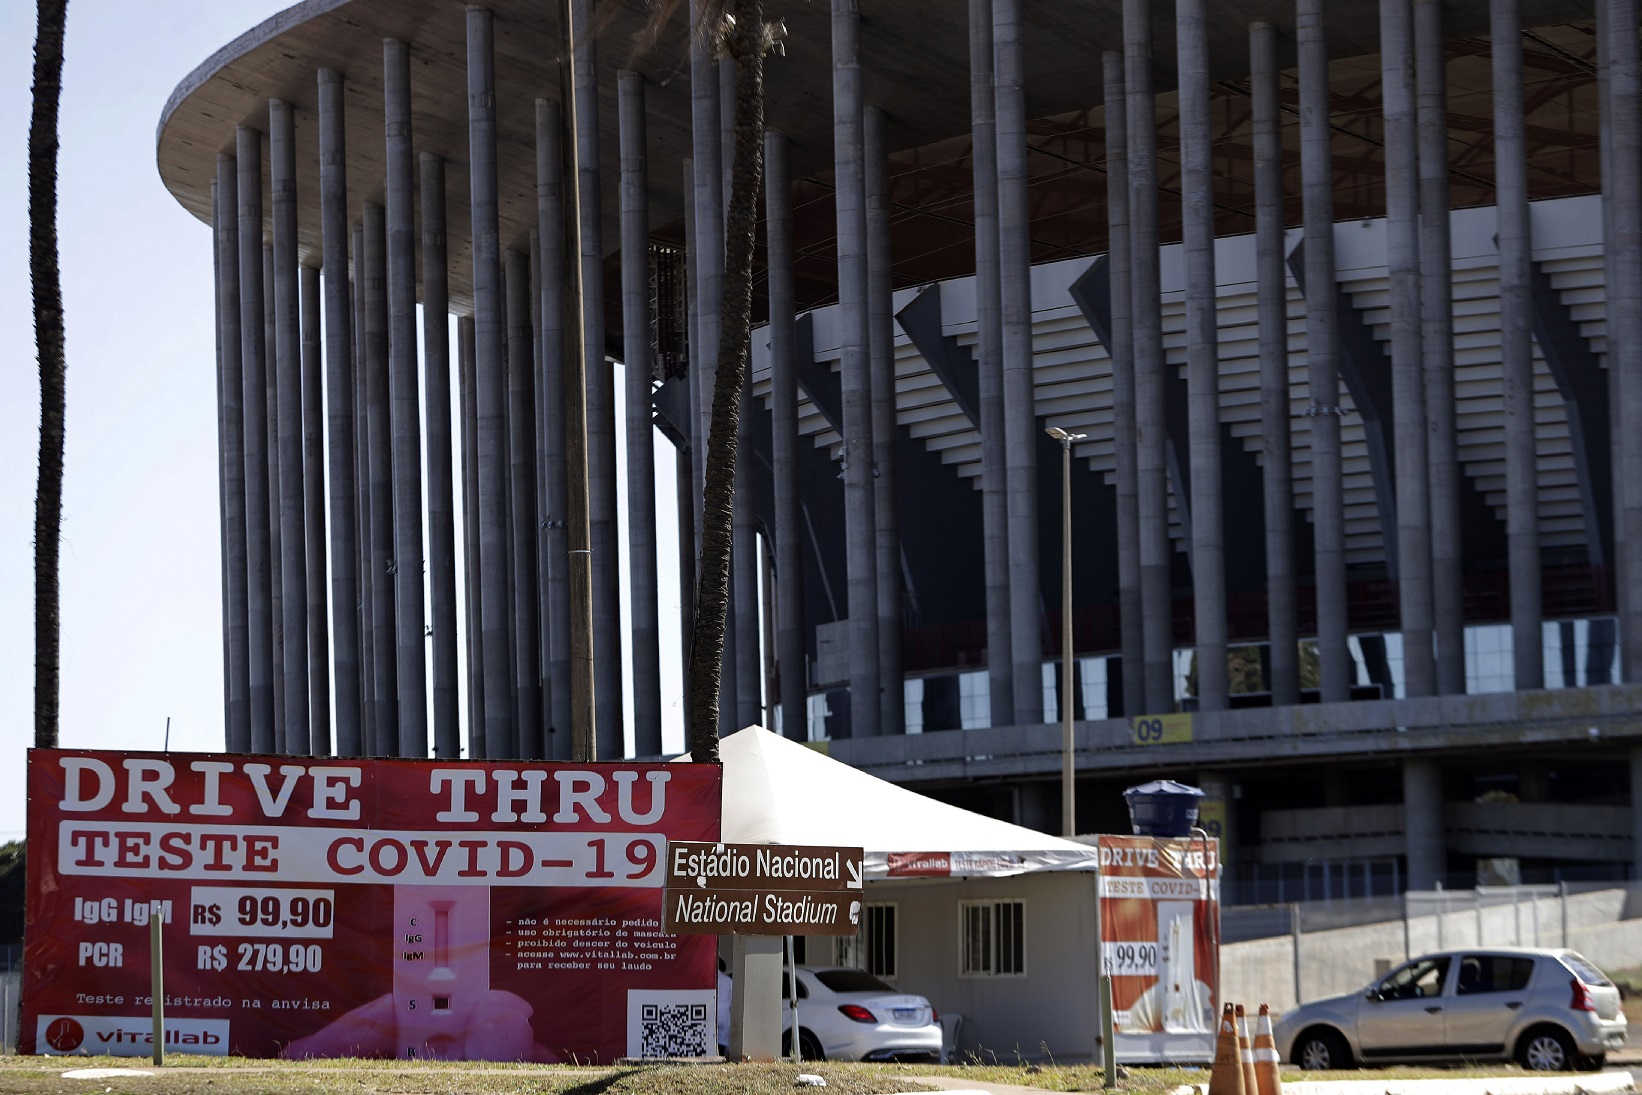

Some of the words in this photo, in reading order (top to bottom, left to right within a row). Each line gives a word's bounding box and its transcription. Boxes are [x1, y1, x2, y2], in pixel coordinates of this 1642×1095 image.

[1138, 718, 1163, 742] 09
[58, 757, 362, 821] DRIVE
[429, 769, 672, 825] THRU
[71, 830, 279, 873] TESTE
[326, 836, 658, 880] COVID-19
[673, 846, 750, 877] Estádio
[756, 849, 839, 880] Nacional
[1101, 847, 1160, 868] DRIVE
[1107, 880, 1145, 894] TESTE
[74, 897, 118, 925] IgG
[124, 898, 173, 927] IgM
[192, 903, 222, 927] R$
[238, 895, 332, 930] 99,90
[675, 894, 759, 923] National
[763, 893, 838, 924] Stadium
[410, 917, 417, 926] C
[518, 917, 537, 926] não
[543, 917, 549, 926] é
[555, 917, 617, 927] necessário
[622, 918, 659, 928] pedido
[405, 933, 422, 944] IgG
[542, 928, 610, 938] obrigatório
[517, 939, 567, 948] proibido
[78, 942, 124, 968] PCR
[197, 944, 228, 972] R$
[237, 943, 322, 975] 279,90
[403, 952, 424, 961] IgM
[560, 950, 677, 960] www.vitallab.com.br
[1116, 944, 1157, 973] 99,90
[517, 962, 542, 970] para
[548, 961, 591, 969] receber
[621, 962, 652, 970] laudo
[76, 993, 125, 1005] Teste
[135, 994, 232, 1008] reistrado
[242, 998, 261, 1009] na
[272, 997, 331, 1010] anvisa
[408, 1000, 416, 1010] S
